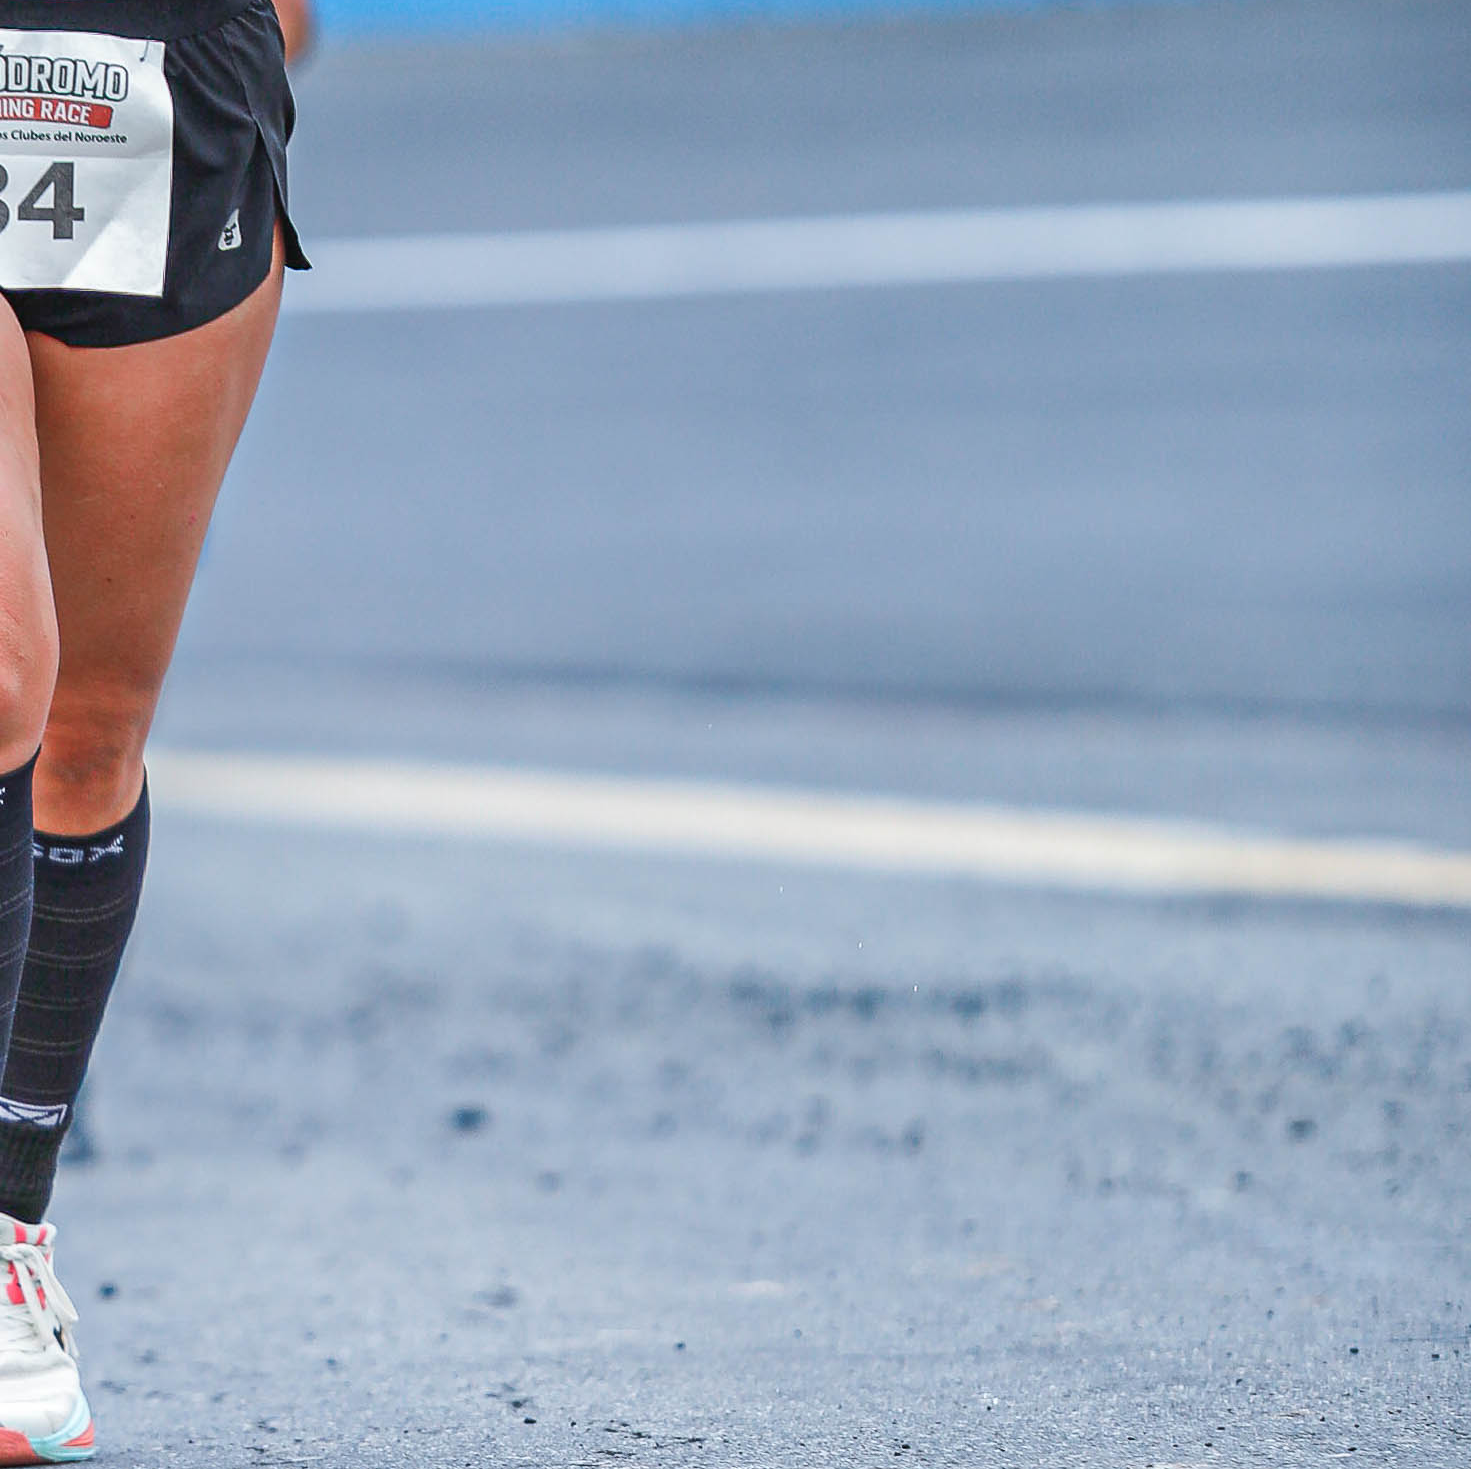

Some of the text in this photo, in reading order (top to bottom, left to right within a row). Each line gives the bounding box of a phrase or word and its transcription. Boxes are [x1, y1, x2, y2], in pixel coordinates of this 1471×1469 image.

[40, 99, 93, 125] RACE
[11, 129, 51, 141] Clubes
[53, 131, 73, 142] del
[75, 132, 128, 144] Noroeste
